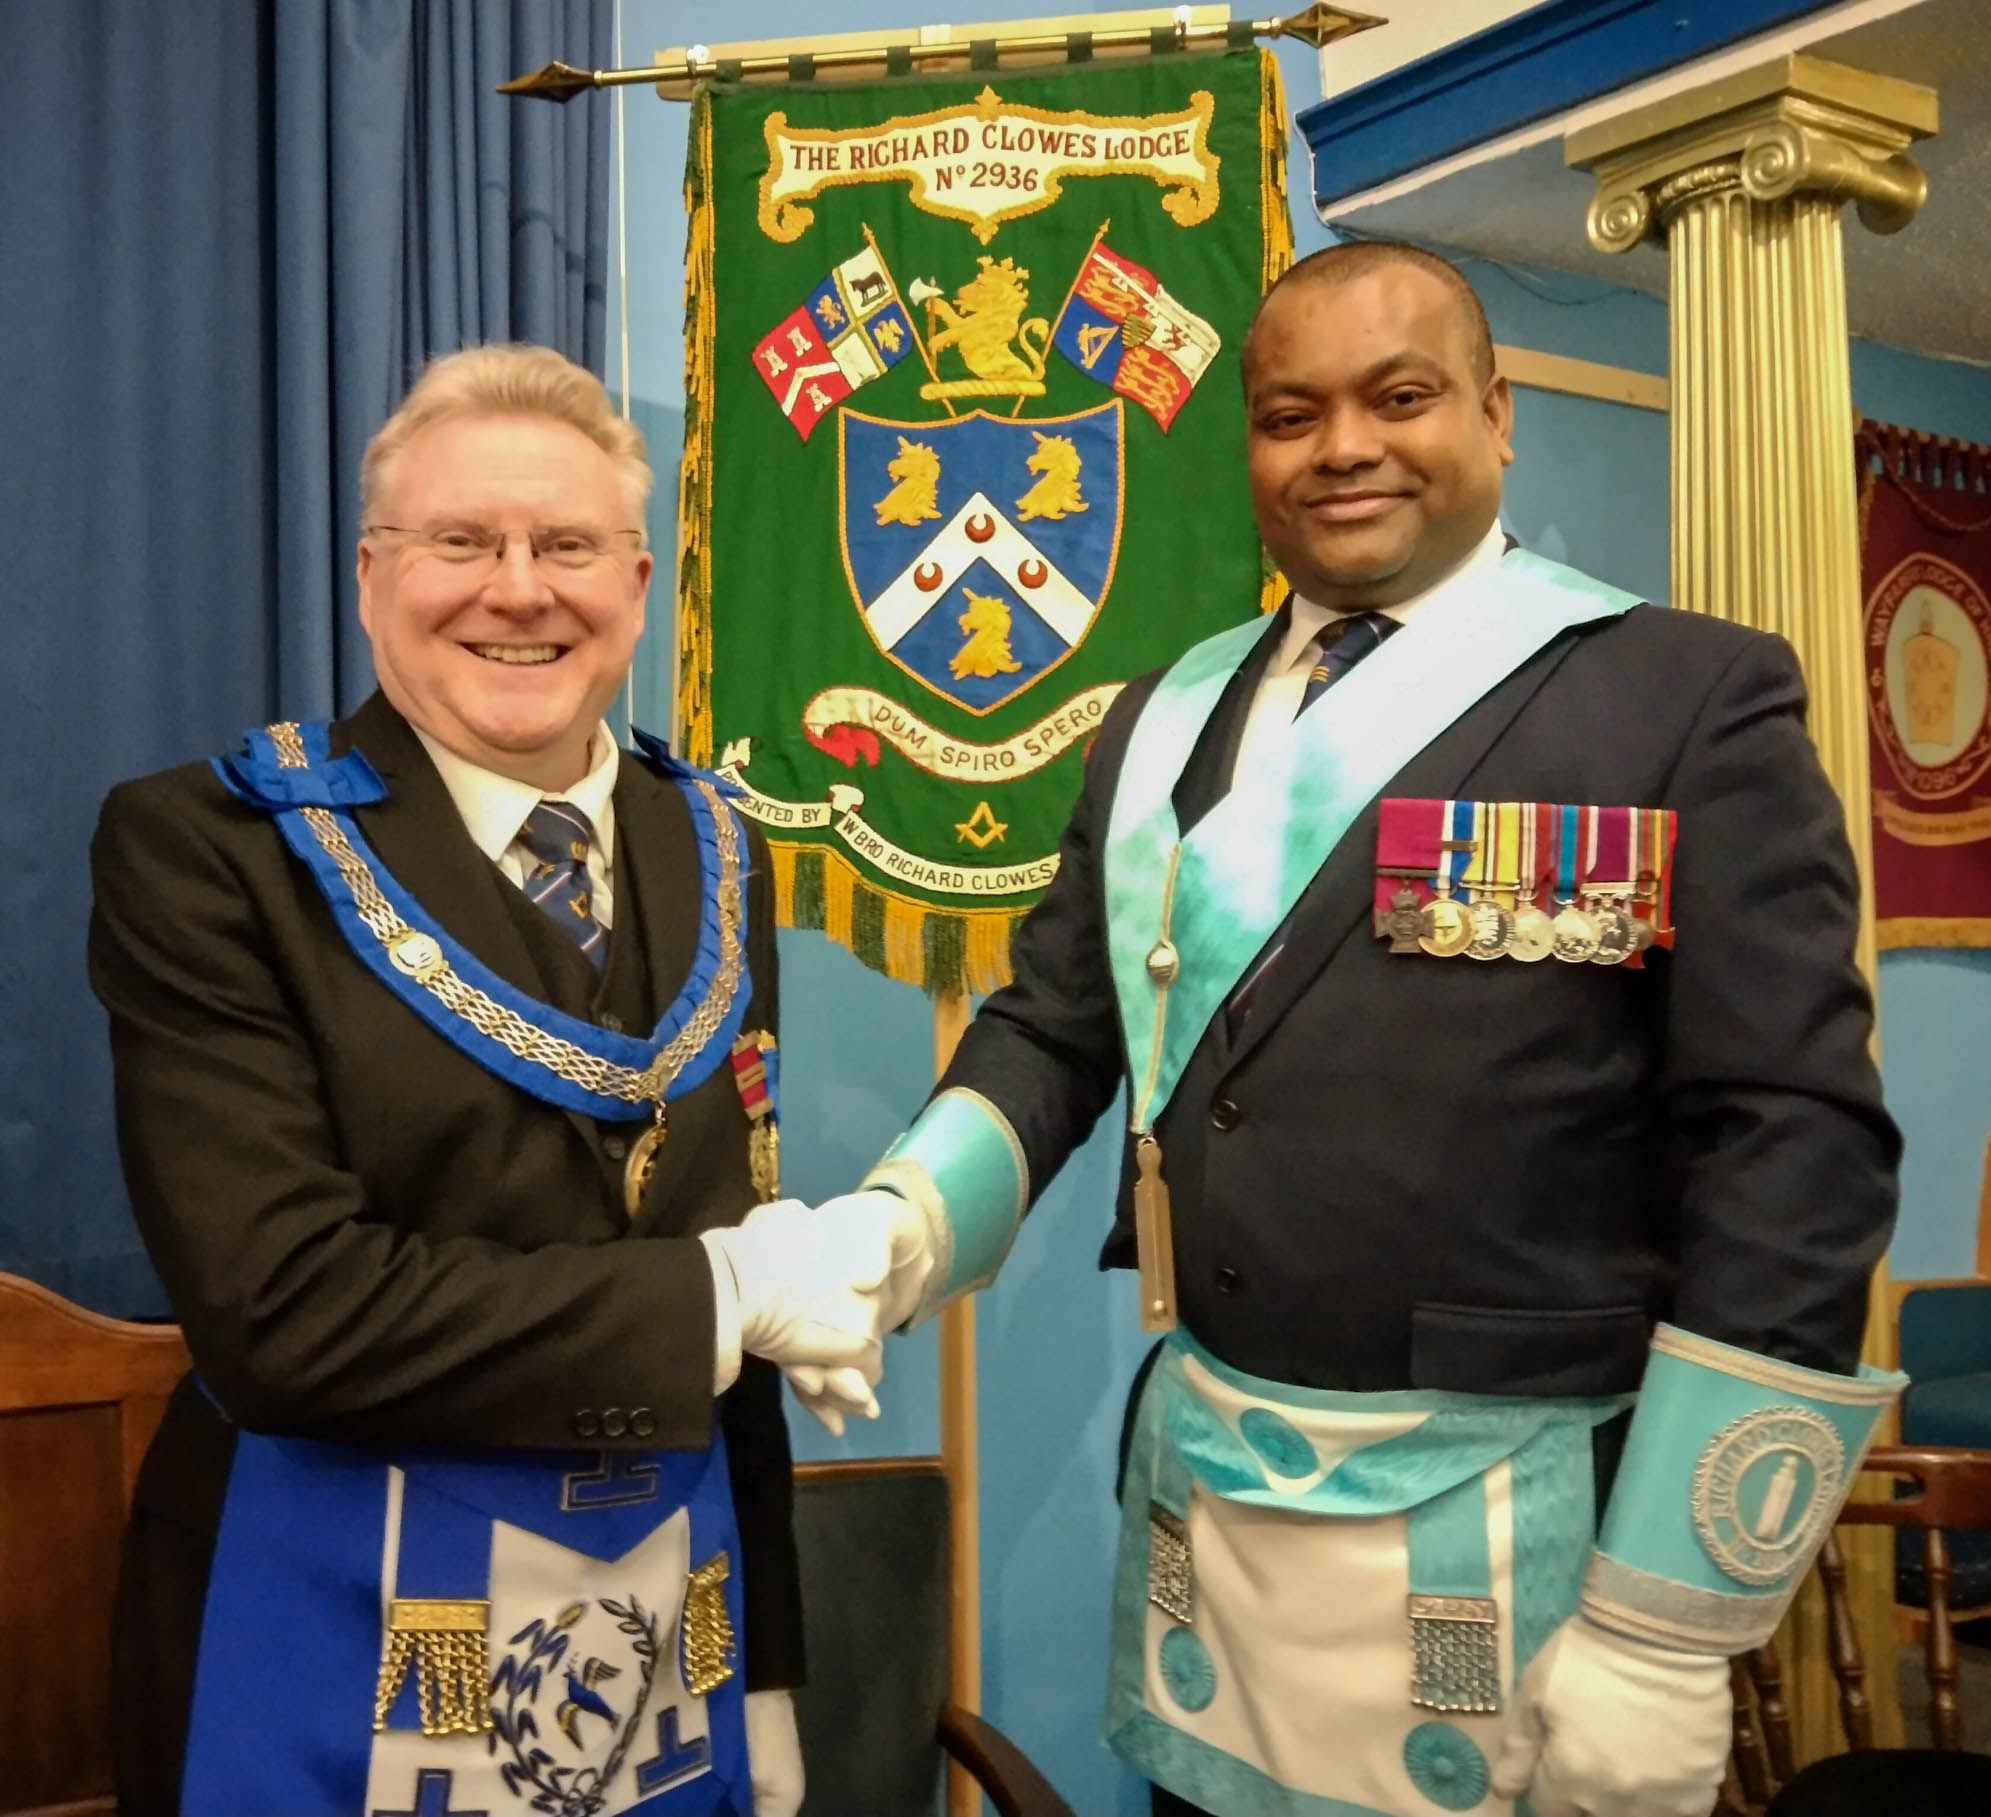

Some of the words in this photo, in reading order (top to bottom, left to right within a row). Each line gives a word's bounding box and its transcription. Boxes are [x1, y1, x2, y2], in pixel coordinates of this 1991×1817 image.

[790, 144, 840, 171] THE
[849, 129, 970, 169] RICHARD
[981, 124, 1097, 159] CLOWES
[1104, 129, 1190, 160] LODGE
[972, 162, 1039, 191] 2936
[874, 706, 928, 749] DUM
[940, 746, 1016, 771] SPIRO
[1023, 699, 1102, 757] SPERO
[802, 808, 822, 824] BY
[886, 854, 964, 889] RICHARD
[972, 863, 1053, 890] CLOWES
